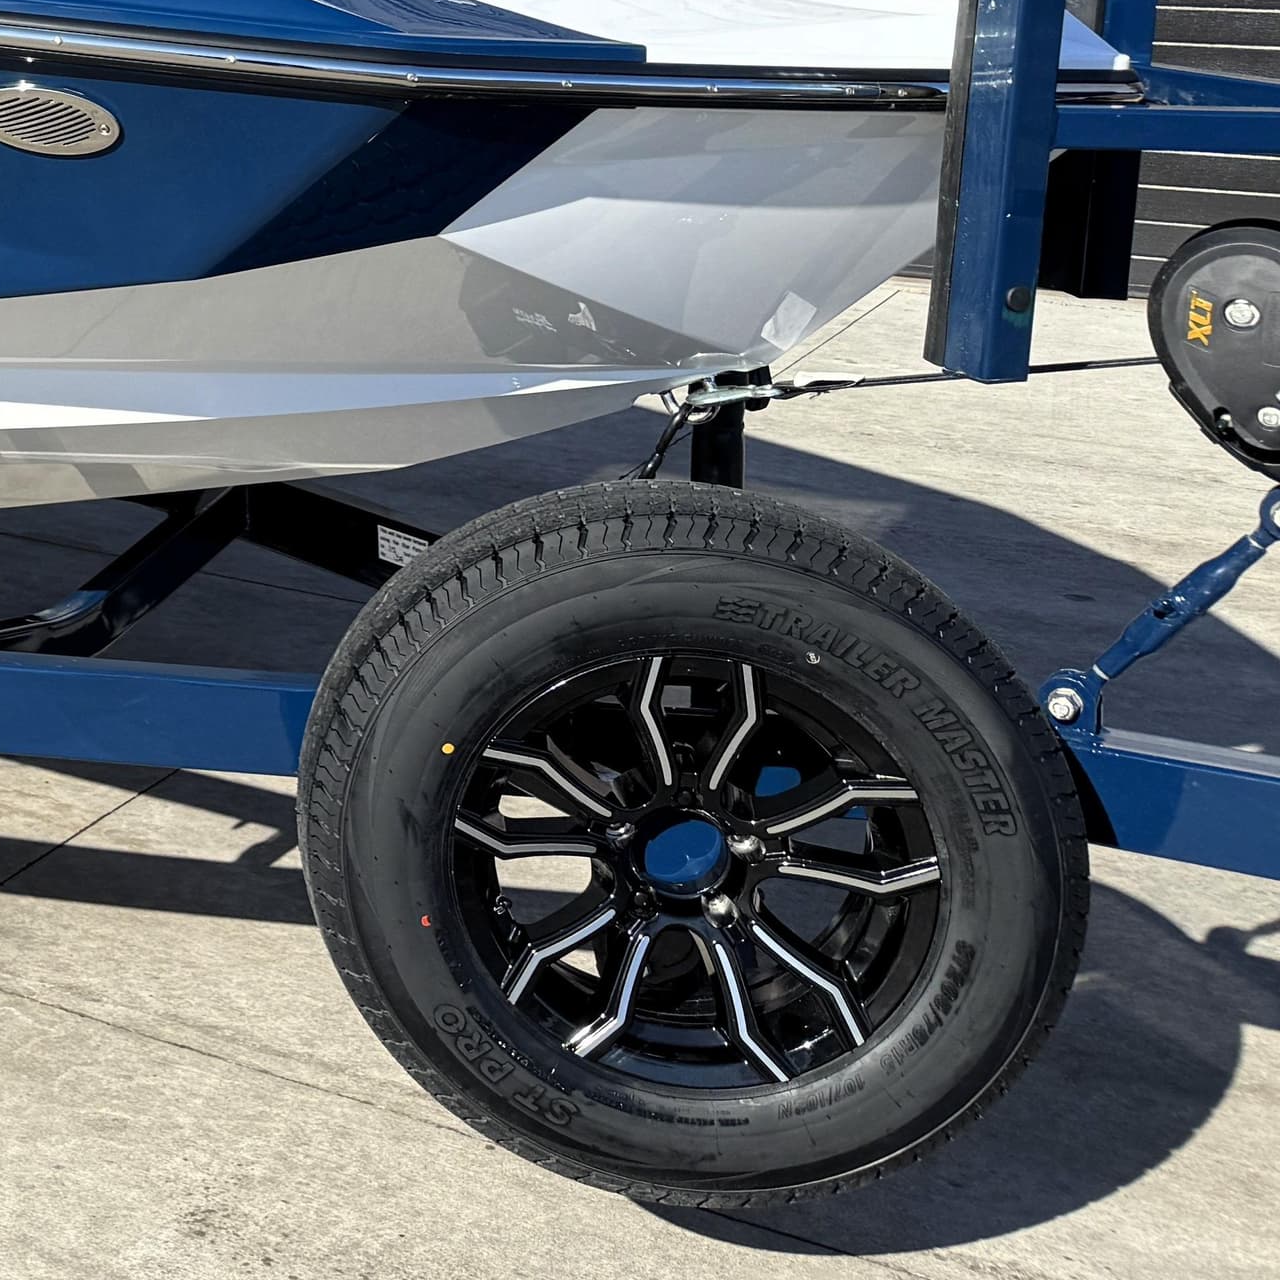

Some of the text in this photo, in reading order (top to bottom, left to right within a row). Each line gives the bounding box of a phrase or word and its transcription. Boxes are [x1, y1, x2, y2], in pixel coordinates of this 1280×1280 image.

[1187, 296, 1213, 346] XLT
[751, 602, 1017, 838] TRAILER MASTER
[435, 1002, 510, 1087] PRO
[507, 1078, 582, 1126] ST
